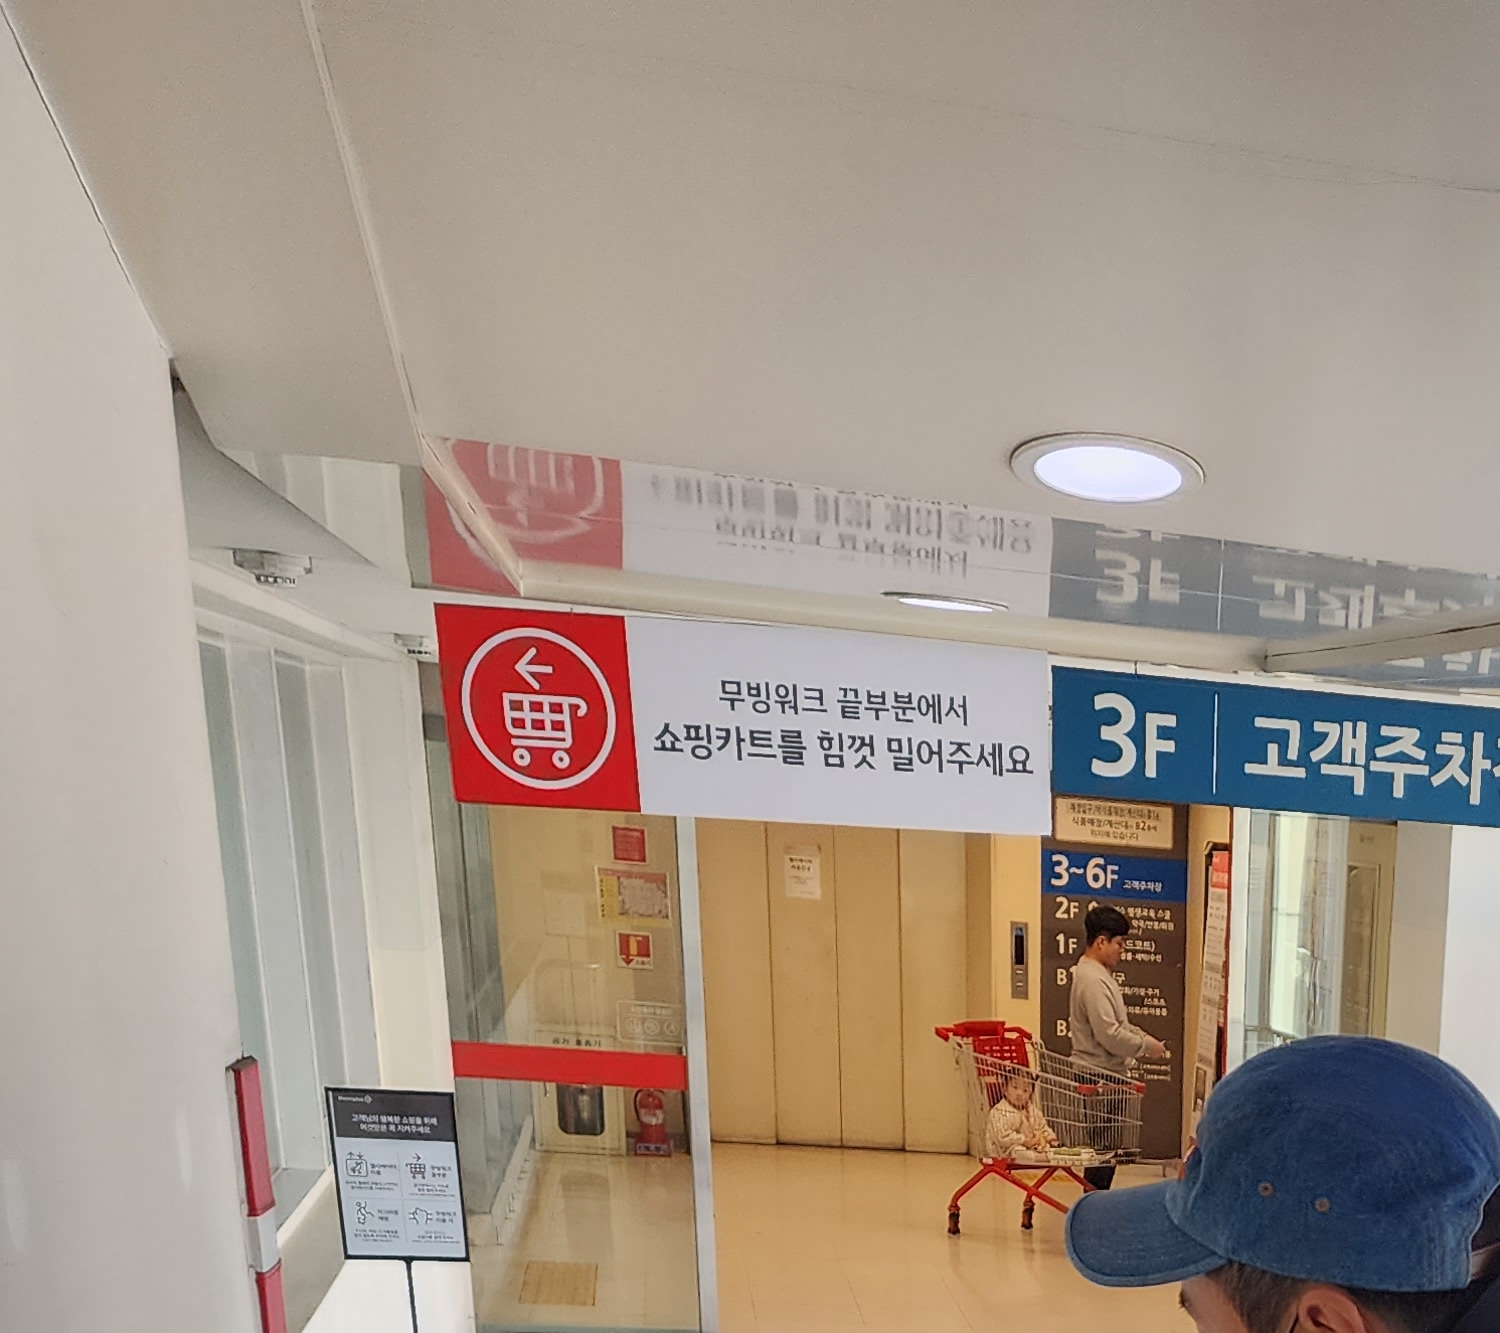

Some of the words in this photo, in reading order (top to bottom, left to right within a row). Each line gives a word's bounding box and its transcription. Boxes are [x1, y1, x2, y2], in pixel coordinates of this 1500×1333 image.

[718, 679, 828, 717] 무빙워크
[836, 686, 969, 726] 끝부분에서
[653, 721, 807, 768] 쇼핑카트를
[816, 730, 877, 772] 힘껏
[885, 734, 1034, 779] 밀어주세요
[1090, 692, 1178, 779] 3F
[1050, 853, 1119, 889] 3~6F
[1122, 879, 1162, 893] 고객주차장
[1055, 896, 1079, 919] 2F
[1056, 933, 1078, 954] 1F
[1124, 939, 1155, 952] 드코트)
